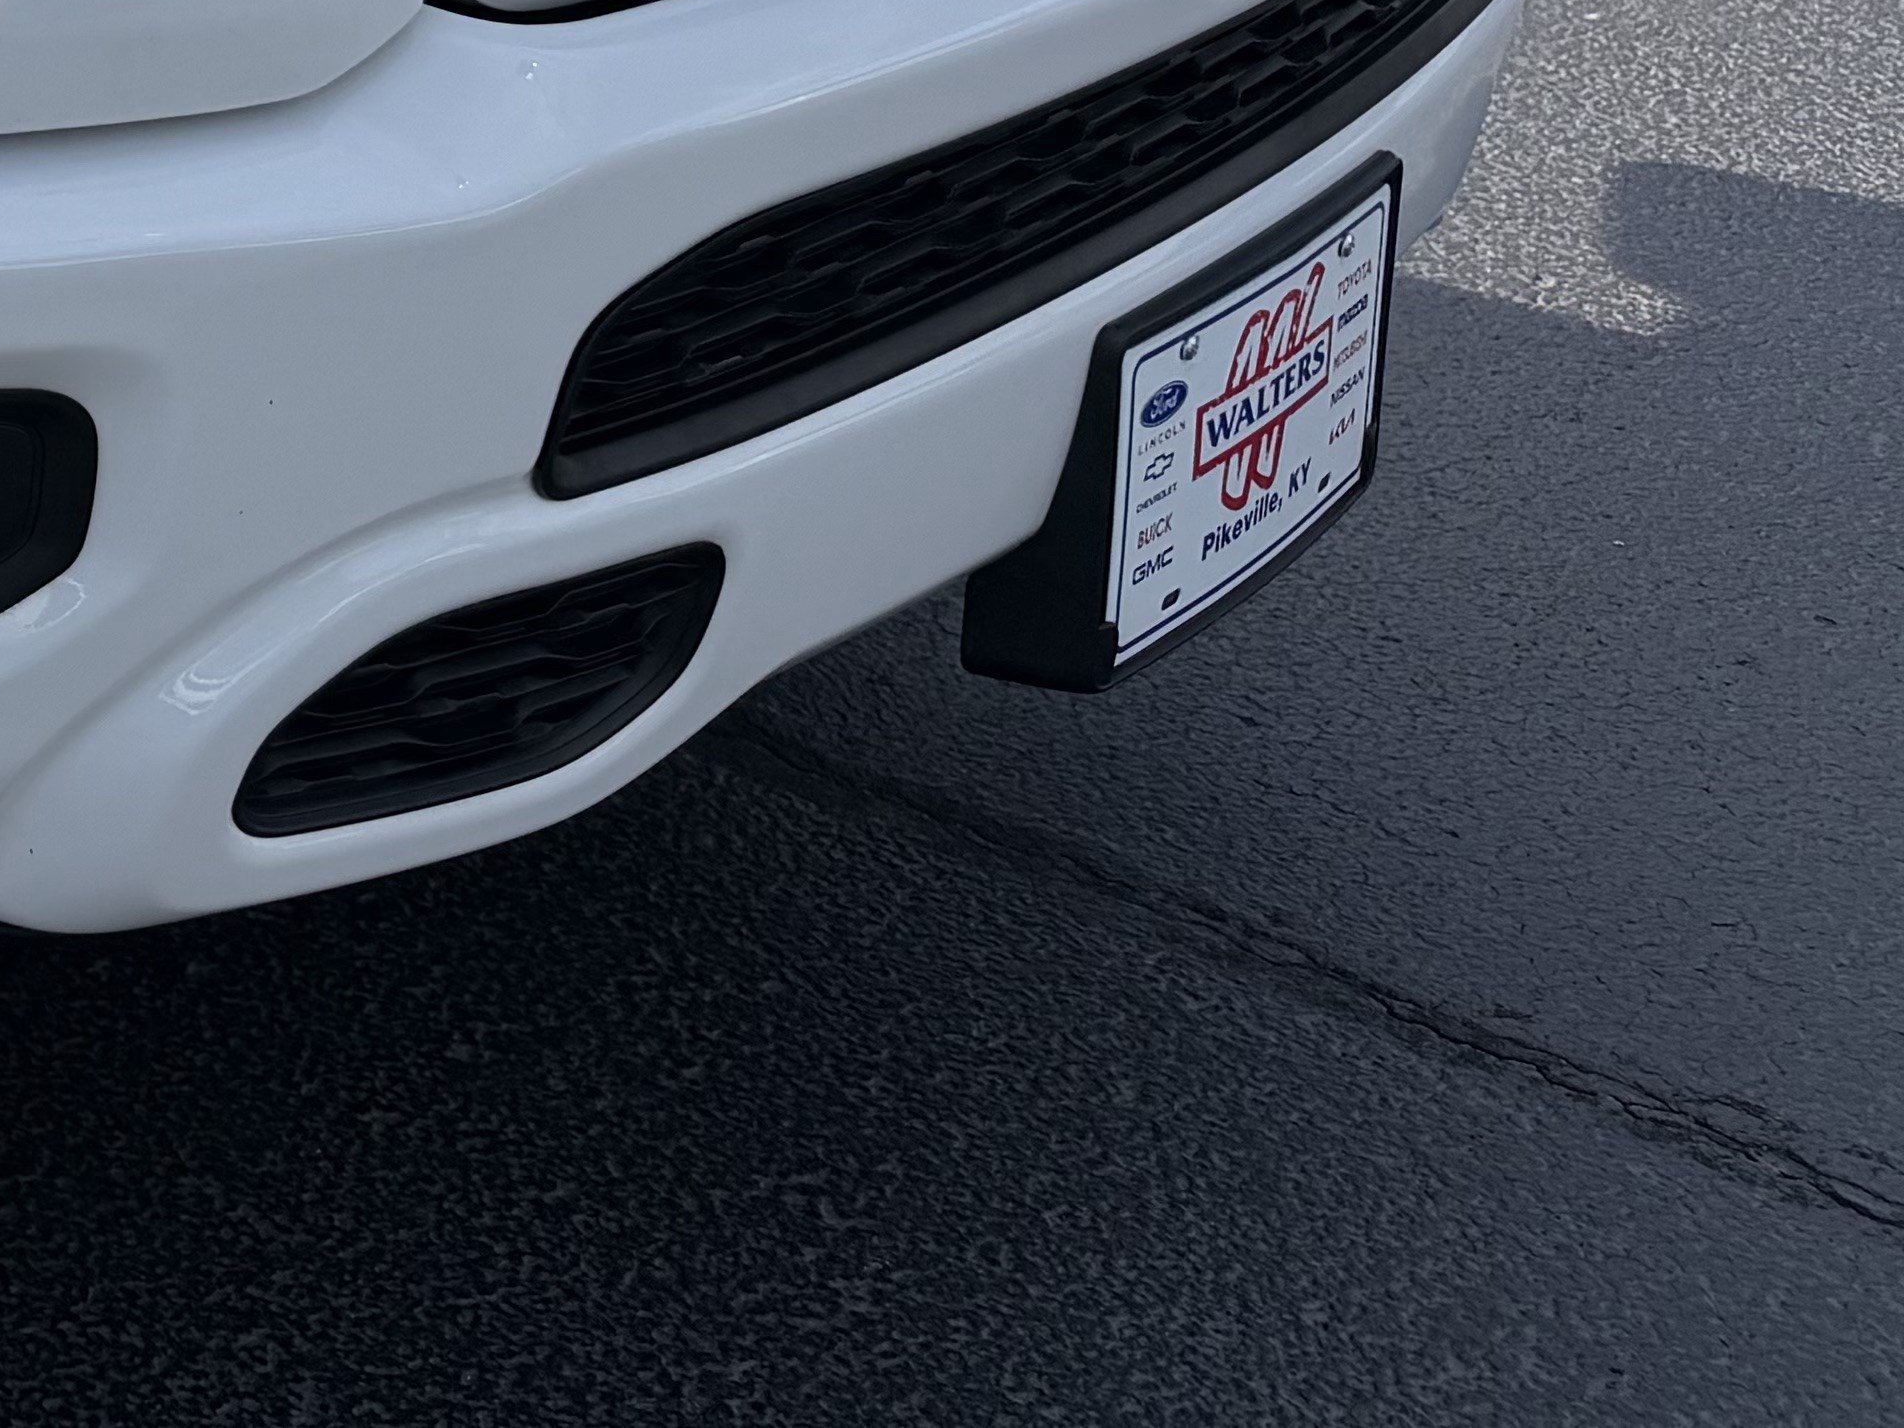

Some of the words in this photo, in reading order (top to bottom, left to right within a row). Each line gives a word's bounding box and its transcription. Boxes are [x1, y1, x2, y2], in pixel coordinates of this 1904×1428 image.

[1337, 258, 1372, 301] TOYOTA
[1206, 340, 1325, 448] WALTERS
[1137, 419, 1186, 457] LINCOLN
[1201, 494, 1284, 562] Pikeville,
[1288, 456, 1312, 498] KY
[1137, 511, 1174, 550] BUICK
[1132, 545, 1175, 586] GMC
